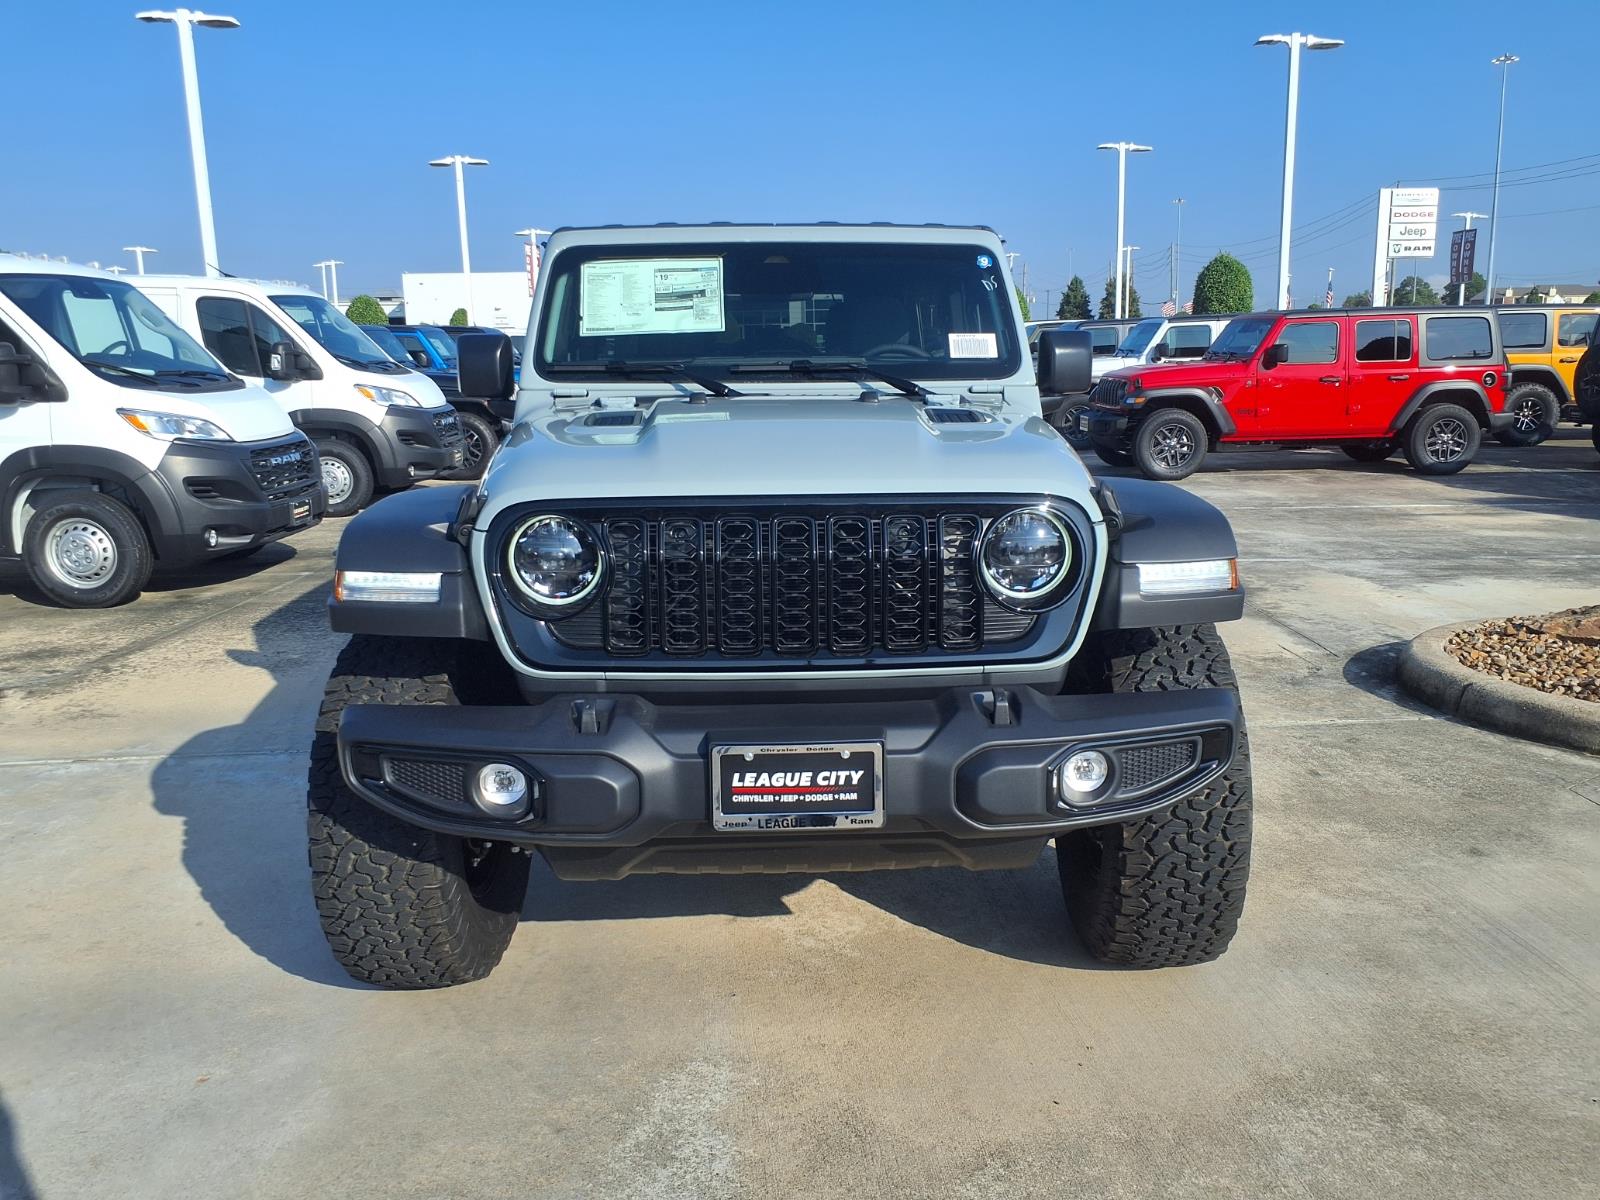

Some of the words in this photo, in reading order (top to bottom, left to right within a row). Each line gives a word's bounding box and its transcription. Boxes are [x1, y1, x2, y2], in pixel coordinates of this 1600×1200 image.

[1399, 226, 1427, 237] Jeep
[659, 273, 669, 281] 19
[271, 452, 302, 466] RAM
[732, 772, 813, 787] LEAGUE
[816, 770, 865, 786] CITY
[732, 794, 774, 803] CHRYSLER
[780, 794, 799, 803] JEEP
[805, 793, 834, 802] DODGE
[839, 793, 858, 801] RAM
[757, 818, 807, 829] LEAGUE
[850, 818, 874, 826] Ram
